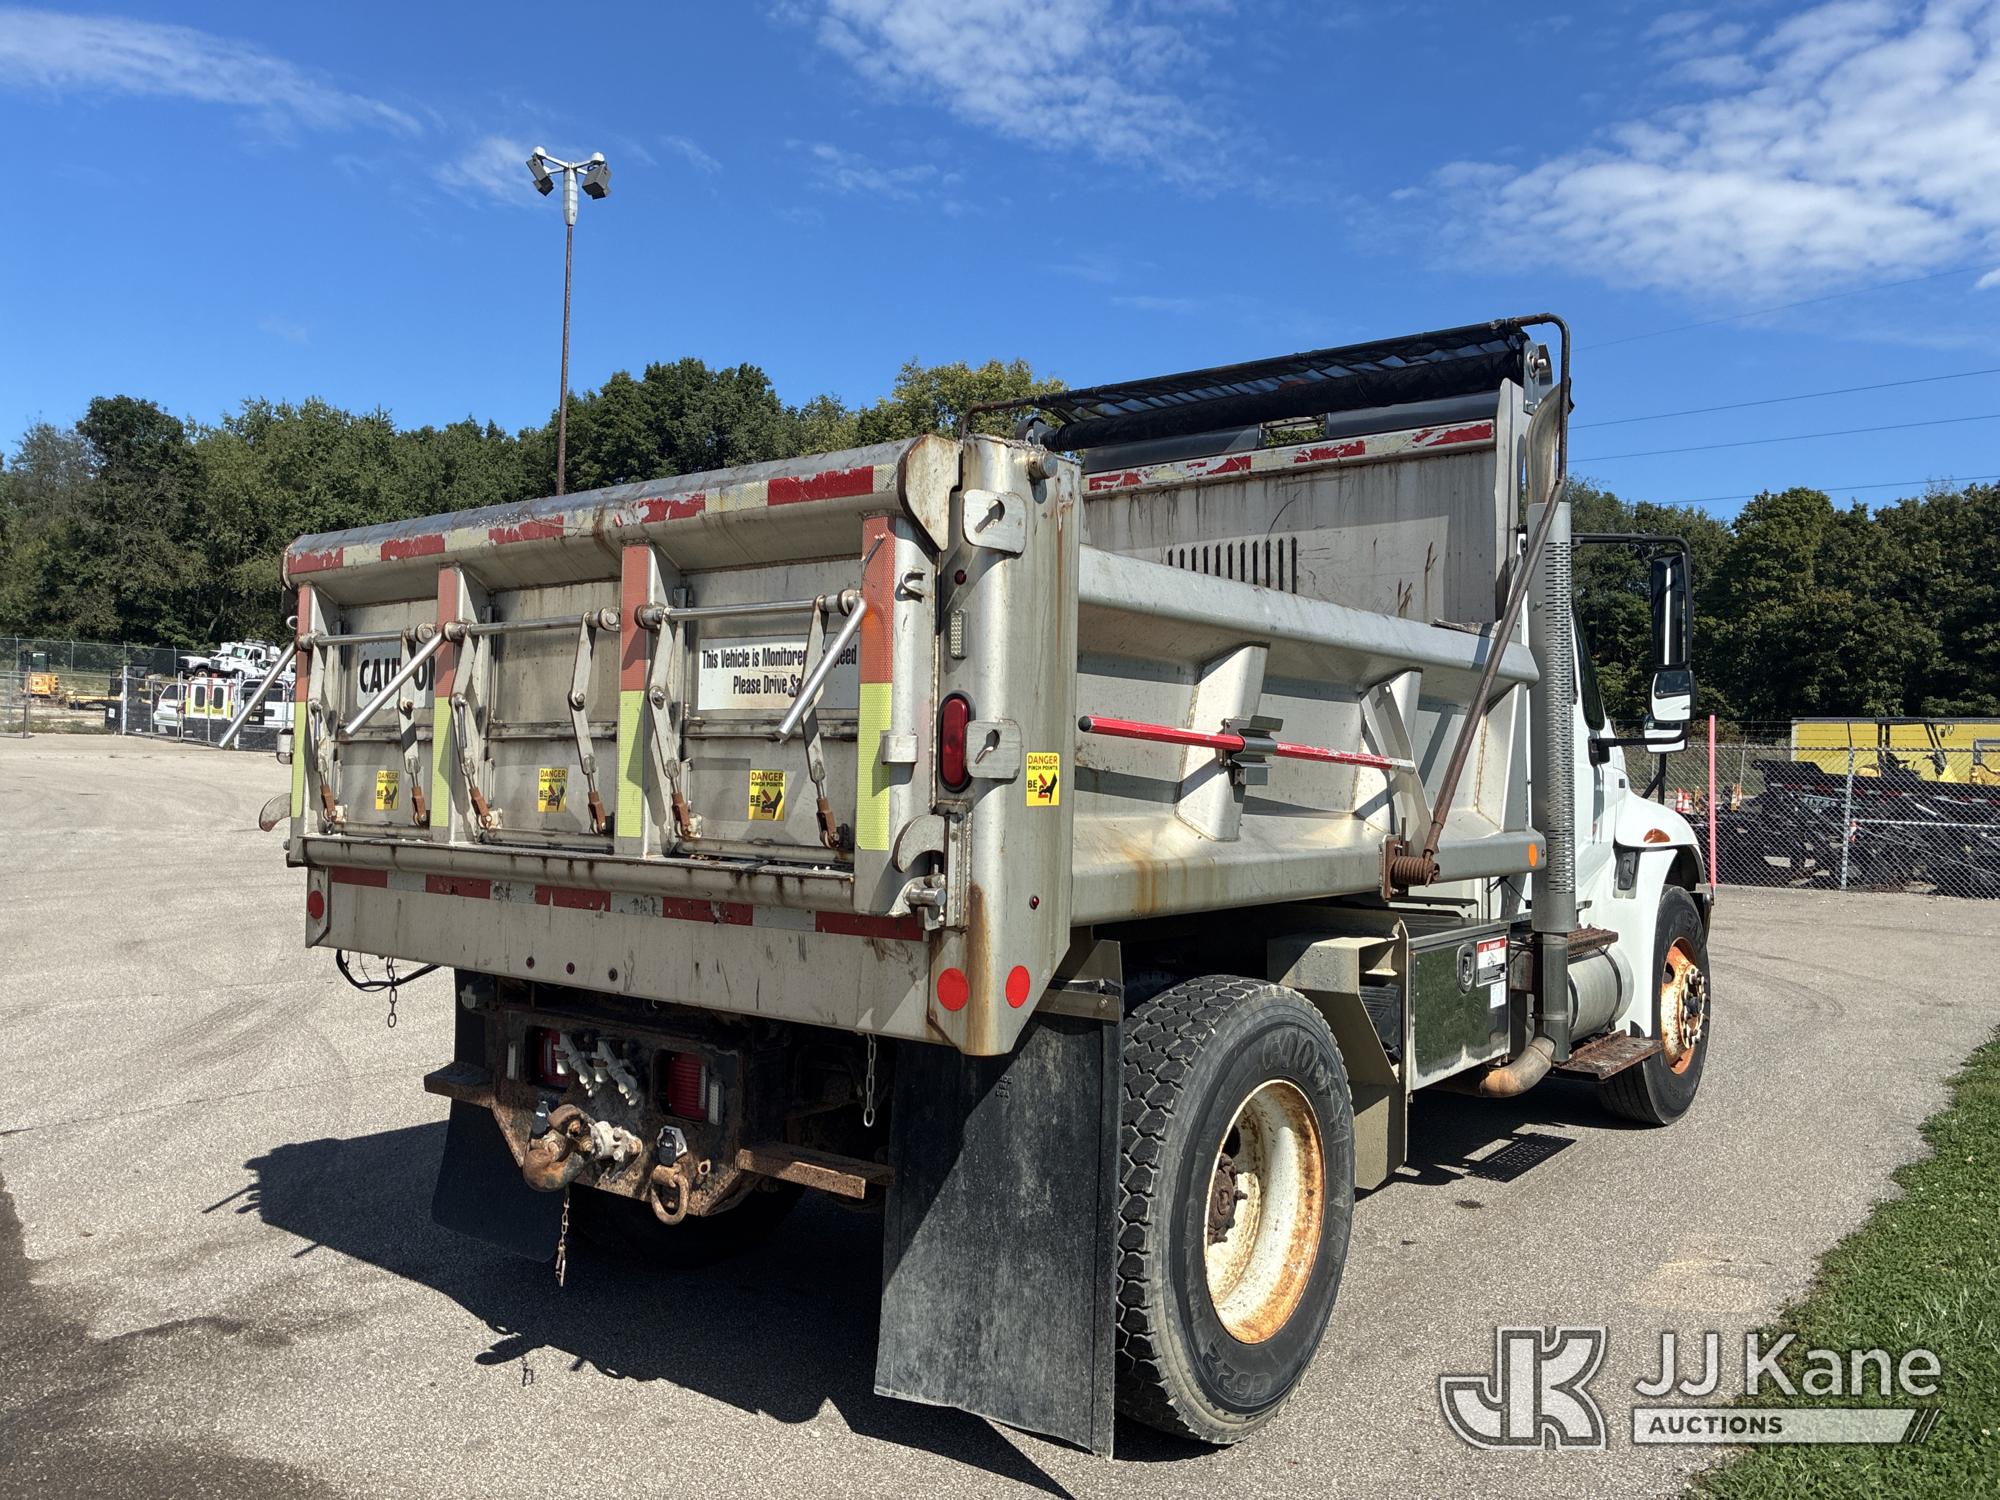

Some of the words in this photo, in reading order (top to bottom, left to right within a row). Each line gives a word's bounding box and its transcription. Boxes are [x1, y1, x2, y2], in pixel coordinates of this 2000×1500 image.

[702, 649, 718, 669] This
[721, 648, 750, 668] Vehicle
[752, 648, 760, 667] is
[733, 675, 761, 694] Please
[763, 675, 787, 694] Drive
[1028, 755, 1058, 764] DANGER
[540, 769, 566, 778] DANGER
[751, 771, 784, 781] DANGER
[1027, 779, 1038, 789] BE
[750, 794, 761, 804] BE
